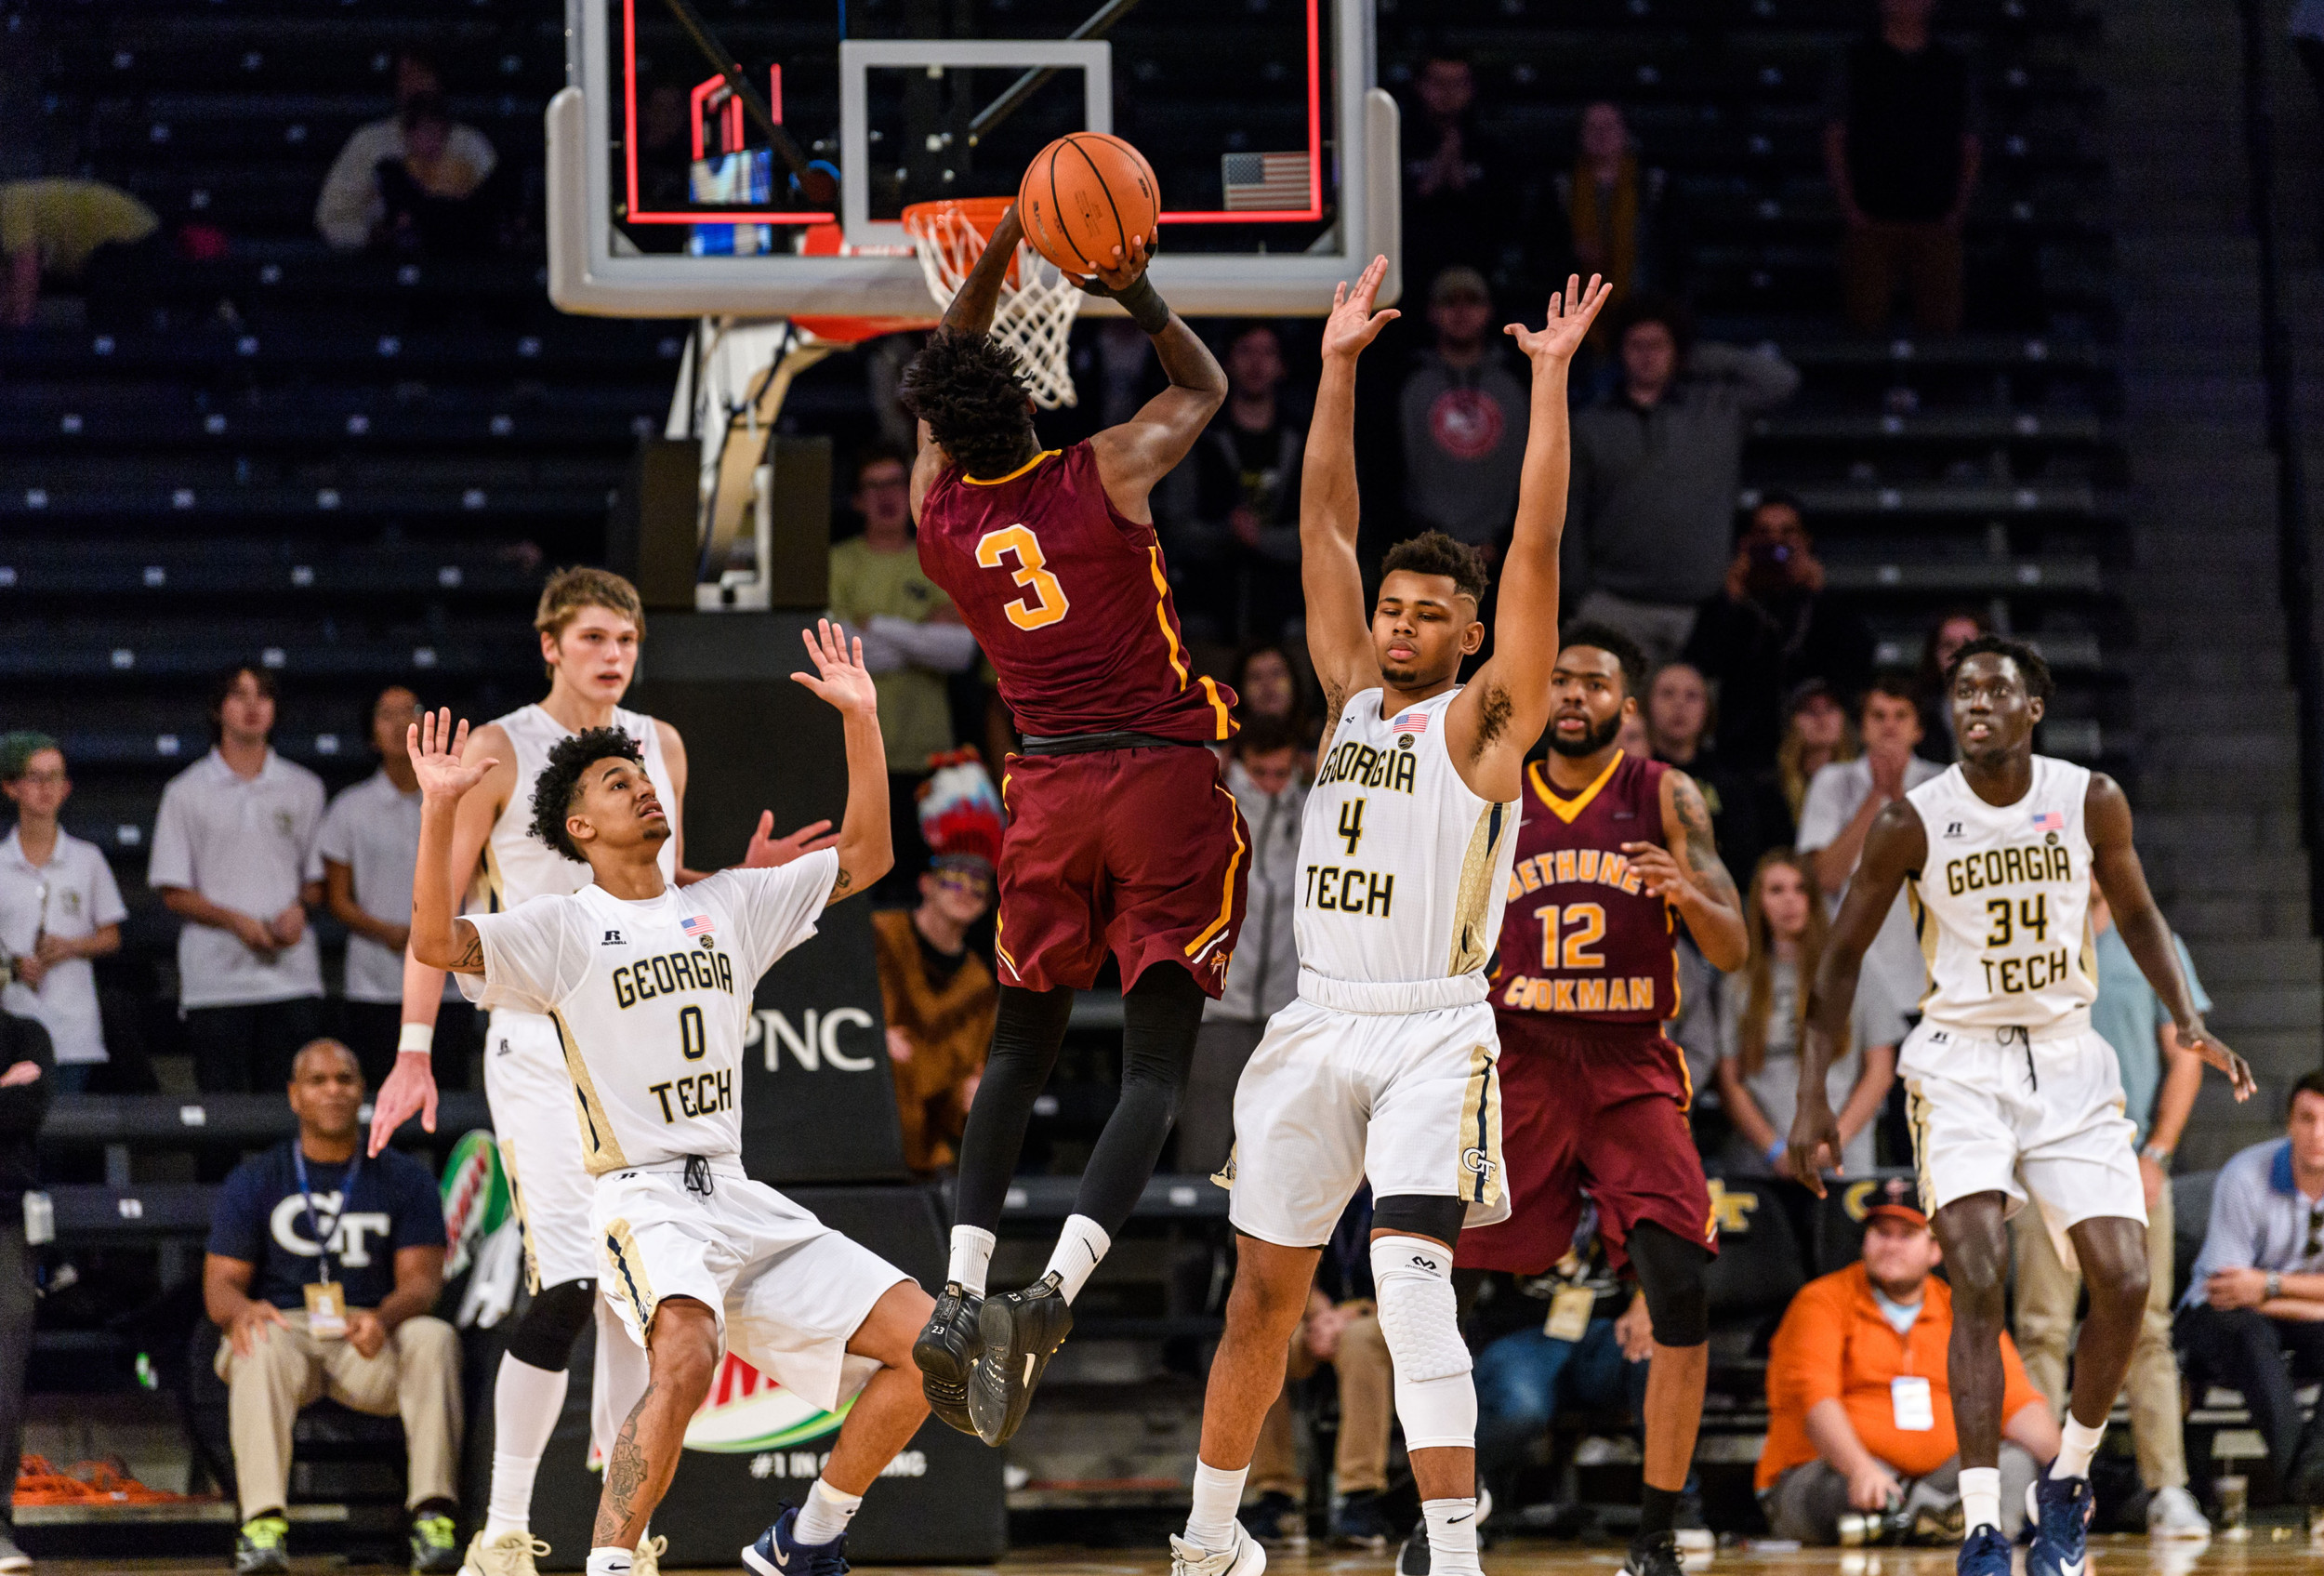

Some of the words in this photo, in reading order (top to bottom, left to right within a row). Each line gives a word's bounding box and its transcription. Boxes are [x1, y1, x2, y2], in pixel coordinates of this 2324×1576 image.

[974, 523, 1070, 631] 3
[1338, 797, 1367, 857] 4
[1305, 864, 1395, 920] TECH
[1947, 845, 2071, 896] GEORGIA
[1534, 902, 1606, 970] 12
[1986, 893, 2049, 948] 34
[613, 950, 734, 1011] GEORGIA
[1980, 947, 2068, 994] TECH
[679, 1003, 706, 1062] 0
[649, 1068, 733, 1124] TECH
[1461, 1146, 1497, 1182] GT
[270, 1189, 391, 1268] GT
[1007, 1292, 1022, 1302] 23
[931, 1325, 945, 1335] 23
